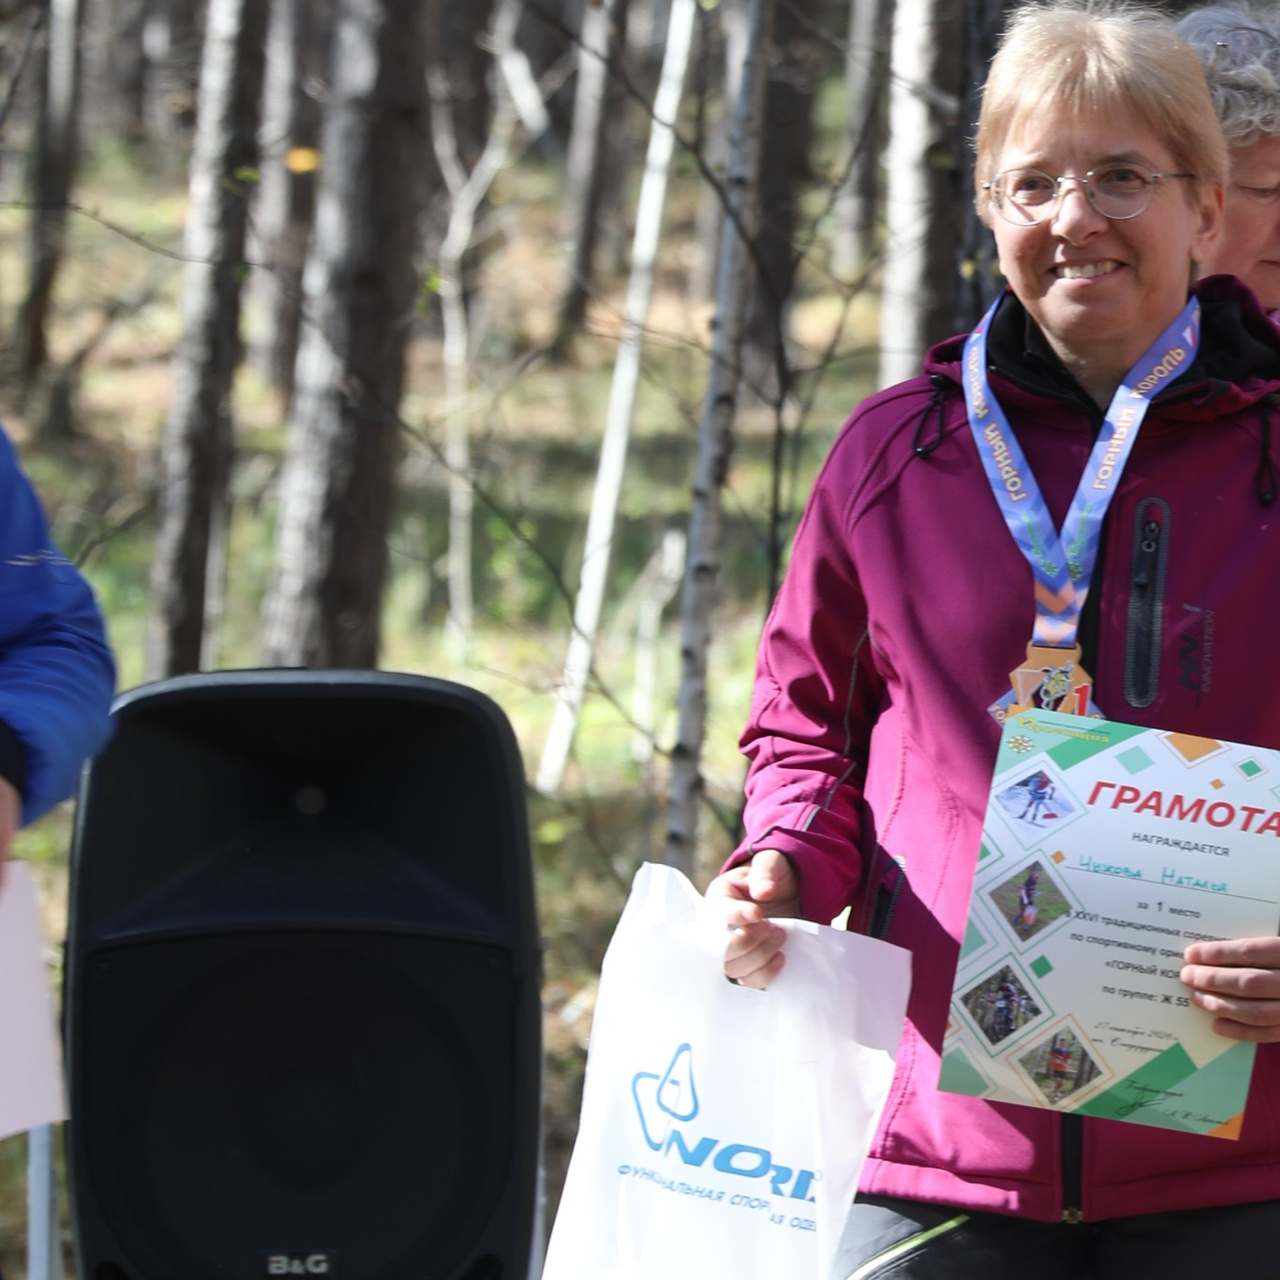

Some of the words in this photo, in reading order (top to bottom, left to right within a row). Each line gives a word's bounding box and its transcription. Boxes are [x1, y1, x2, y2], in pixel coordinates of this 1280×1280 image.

[1092, 407, 1136, 490] ГОРНЫЙ
[1128, 347, 1187, 400] КОРОЛЬ
[984, 422, 1028, 503] ГОРНЫЙ
[1132, 832, 1230, 857] НАГРАЖДАЕТСЯ
[1161, 867, 1228, 893] Наталья
[1168, 907, 1201, 919] место
[1069, 933, 1084, 942] по
[1086, 936, 1158, 956] спортивному
